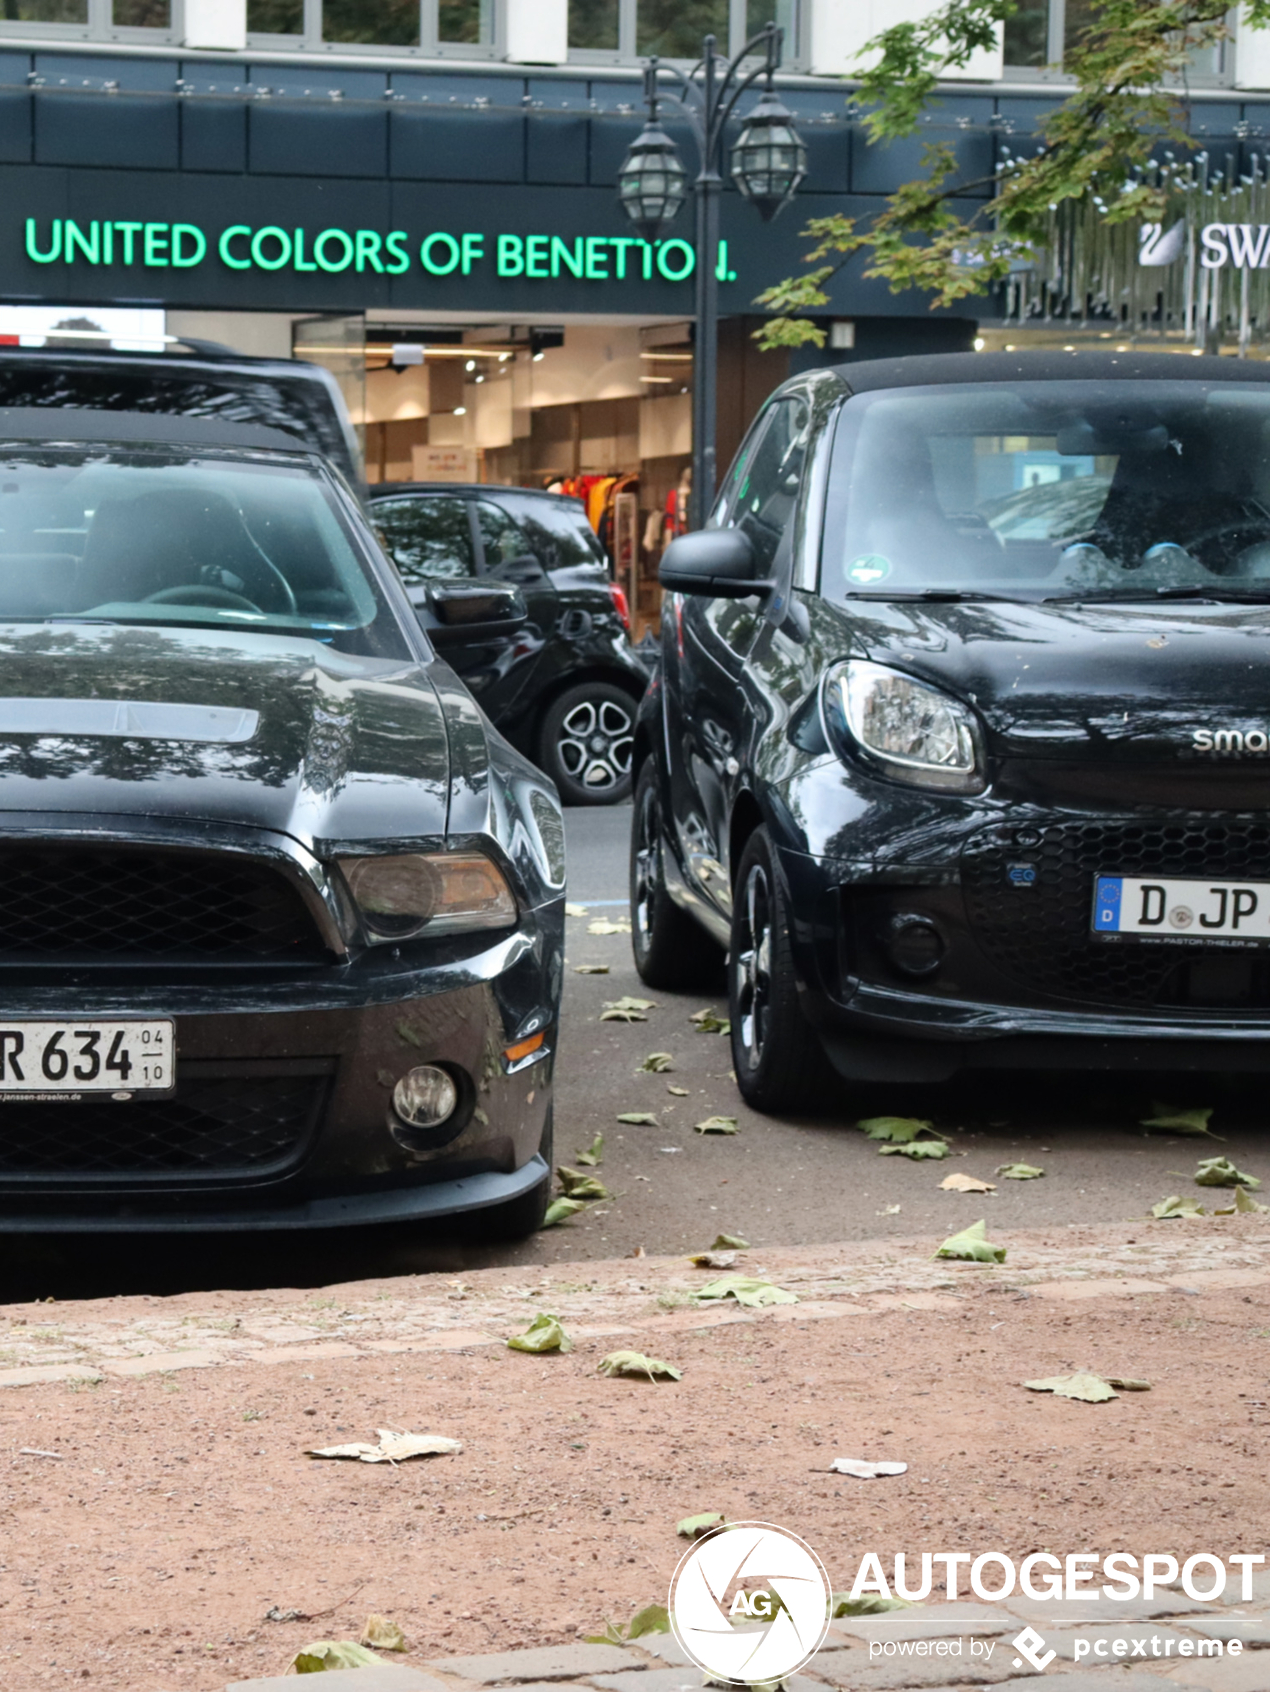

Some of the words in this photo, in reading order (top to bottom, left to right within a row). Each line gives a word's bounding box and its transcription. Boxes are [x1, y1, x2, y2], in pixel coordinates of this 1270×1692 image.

[25, 217, 207, 269] UNITED
[218, 224, 411, 275] COLORS
[420, 231, 485, 276] OF
[1200, 222, 1270, 268] SW
[1192, 729, 1270, 752] sma
[1010, 869, 1036, 881] EQ
[1102, 909, 1113, 922] D
[1138, 885, 1166, 925] D
[1199, 888, 1258, 929] JP
[141, 1030, 163, 1044] 04
[41, 1030, 132, 1081] 634
[143, 1066, 163, 1080] 10
